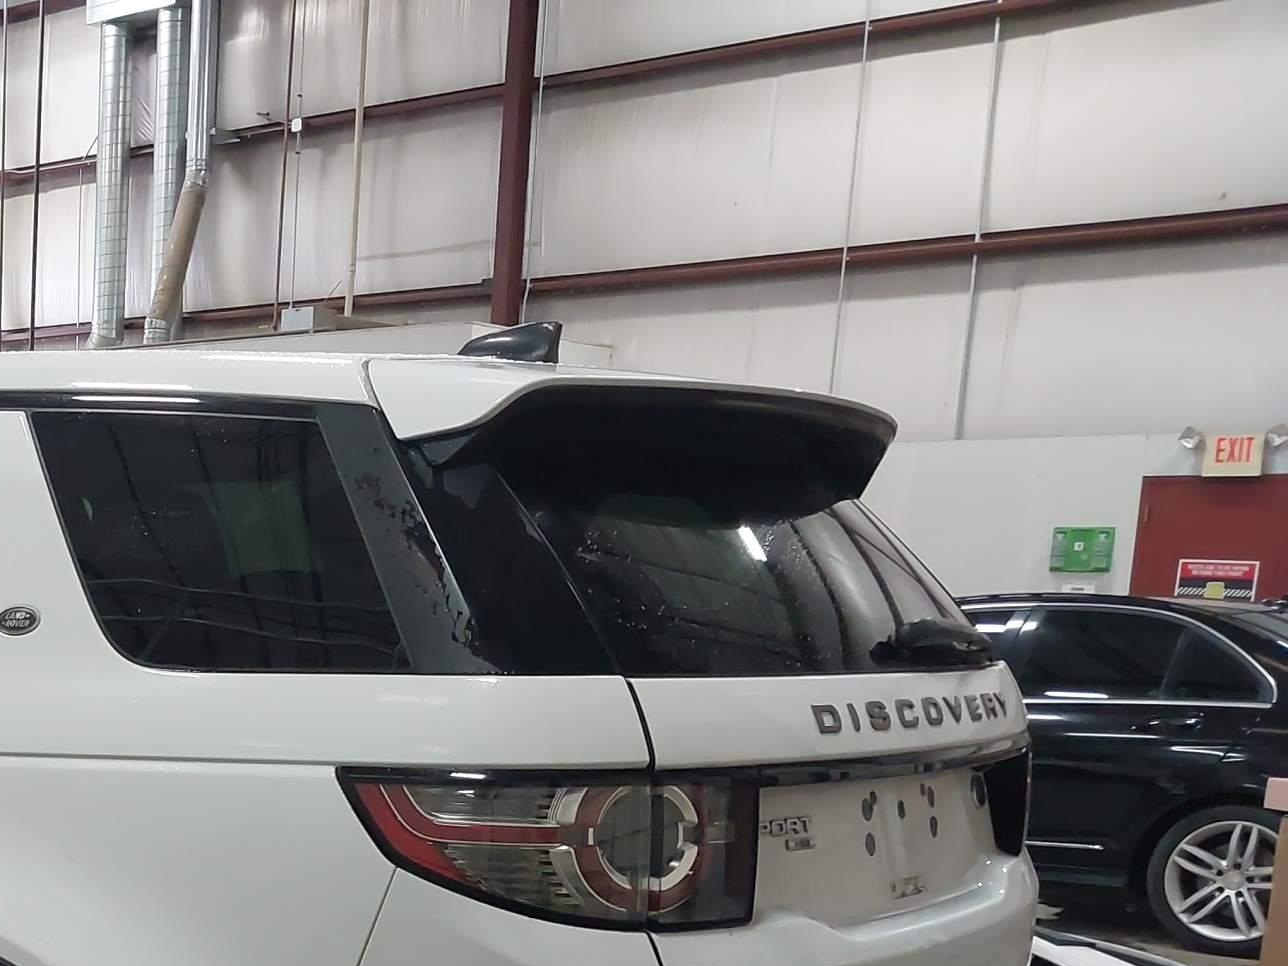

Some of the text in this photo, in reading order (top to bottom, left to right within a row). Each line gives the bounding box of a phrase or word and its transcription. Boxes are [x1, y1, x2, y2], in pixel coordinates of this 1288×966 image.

[1215, 436, 1255, 463] EXIT
[810, 692, 1007, 734] DISCOVERY
[760, 816, 809, 837] PORT
